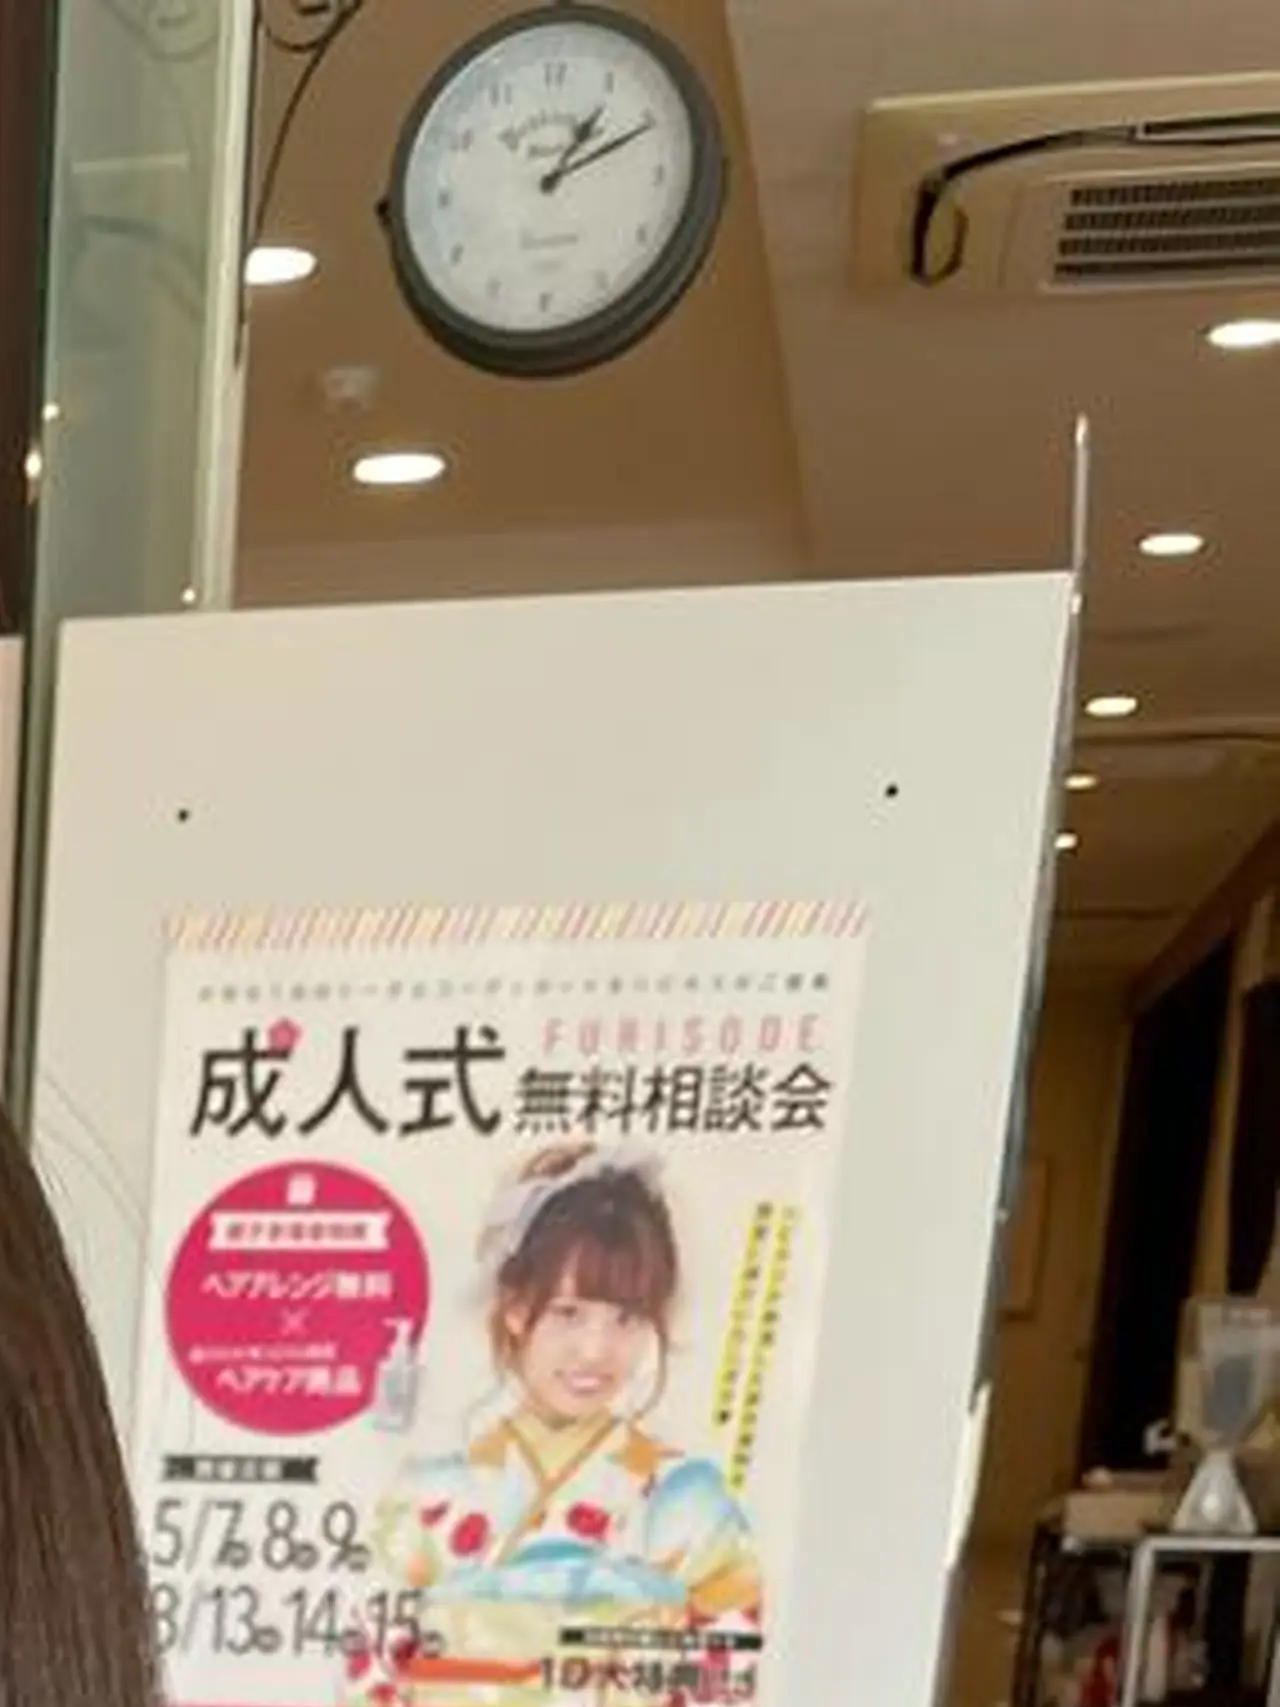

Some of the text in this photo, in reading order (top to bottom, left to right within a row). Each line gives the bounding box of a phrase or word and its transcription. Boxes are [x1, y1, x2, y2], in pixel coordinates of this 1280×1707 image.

[541, 1013, 822, 1056] FURISODE
[189, 1024, 833, 1138] 成人式 無料相談会
